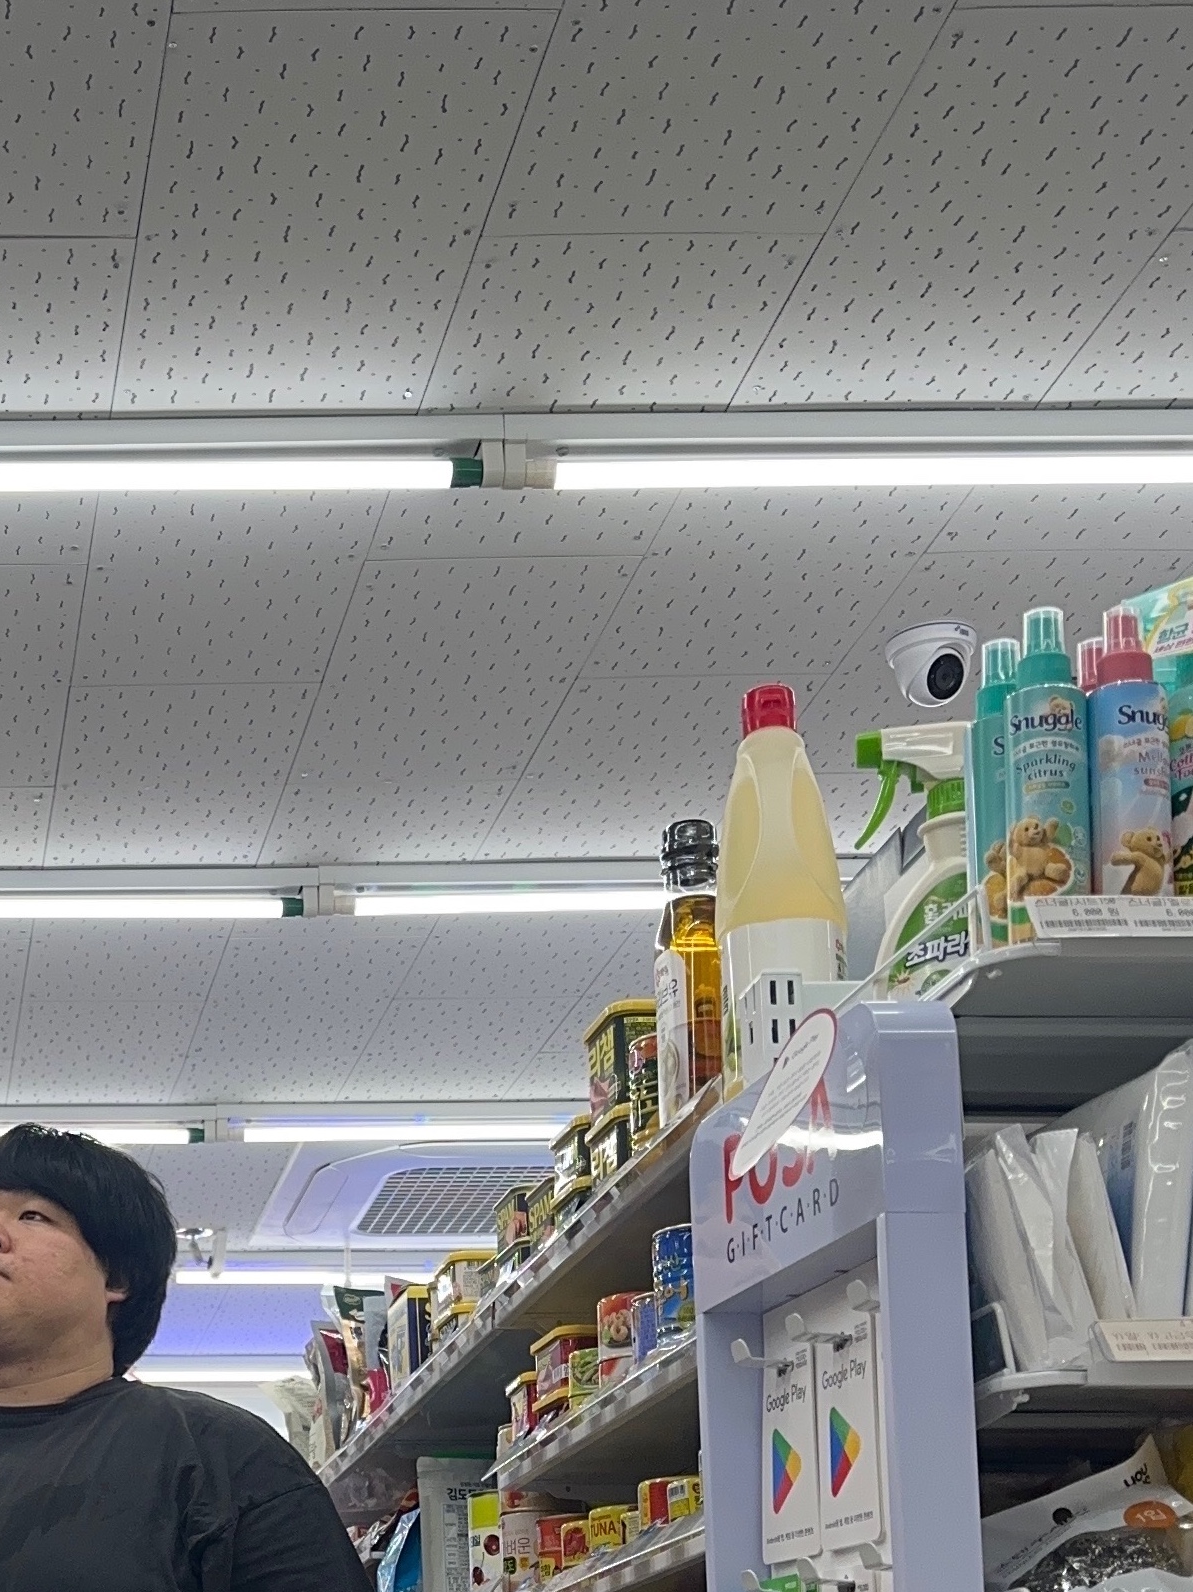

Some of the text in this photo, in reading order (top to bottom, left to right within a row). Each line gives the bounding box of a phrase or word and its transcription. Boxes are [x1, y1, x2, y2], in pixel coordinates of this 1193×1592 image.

[1010, 703, 1082, 735] Snuggle
[1016, 753, 1077, 775] Sparkling
[1028, 769, 1064, 782] citrus
[822, 1359, 867, 1390] Google Play
[767, 1383, 807, 1413] Google Play
[591, 1520, 618, 1539] TUNA
